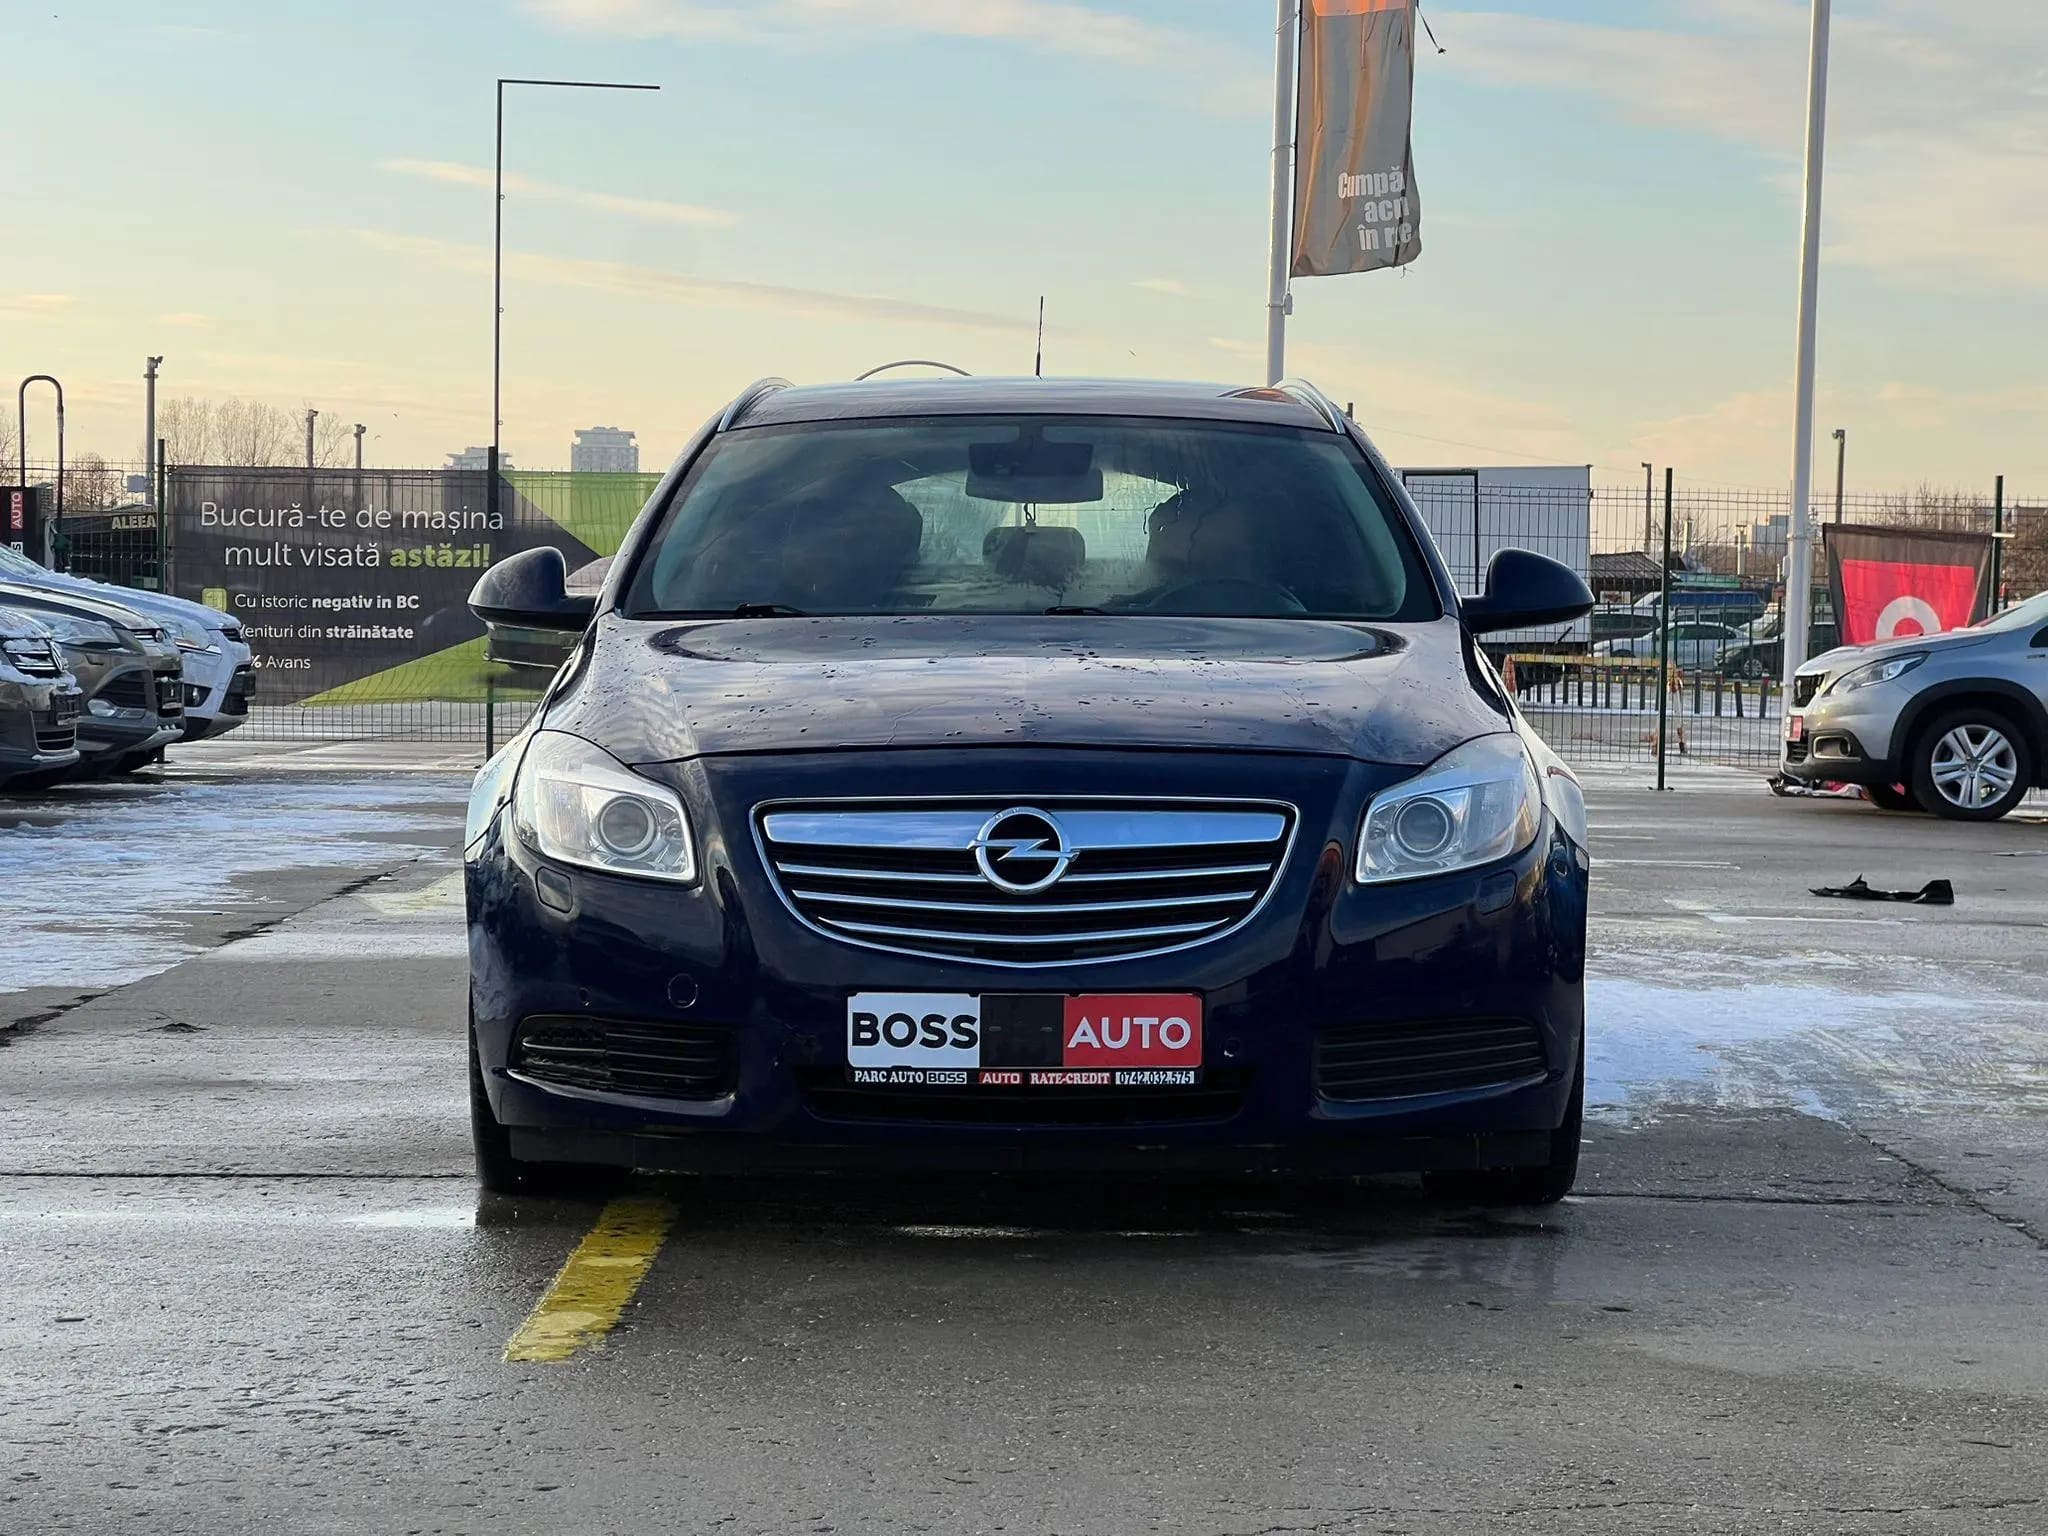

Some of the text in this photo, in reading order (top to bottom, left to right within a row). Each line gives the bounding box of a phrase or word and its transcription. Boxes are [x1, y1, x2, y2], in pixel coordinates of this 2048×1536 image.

[1357, 224, 1379, 250] în
[11, 492, 22, 528] AUTO
[201, 501, 503, 535] Bucură-te de mașina
[111, 515, 157, 529] ALEEA
[225, 541, 490, 568] mult visată astăzi!
[234, 594, 419, 611] Cu istoric negativ in BC
[297, 624, 321, 639] din
[326, 624, 414, 639] străinătate
[265, 655, 311, 669] Avans
[852, 1012, 1192, 1049] BOSS AUTO
[854, 1070, 887, 1083] PARC
[889, 1071, 924, 1083] AUTO
[928, 1073, 965, 1083] BOSS
[982, 1072, 1020, 1084] AUTO
